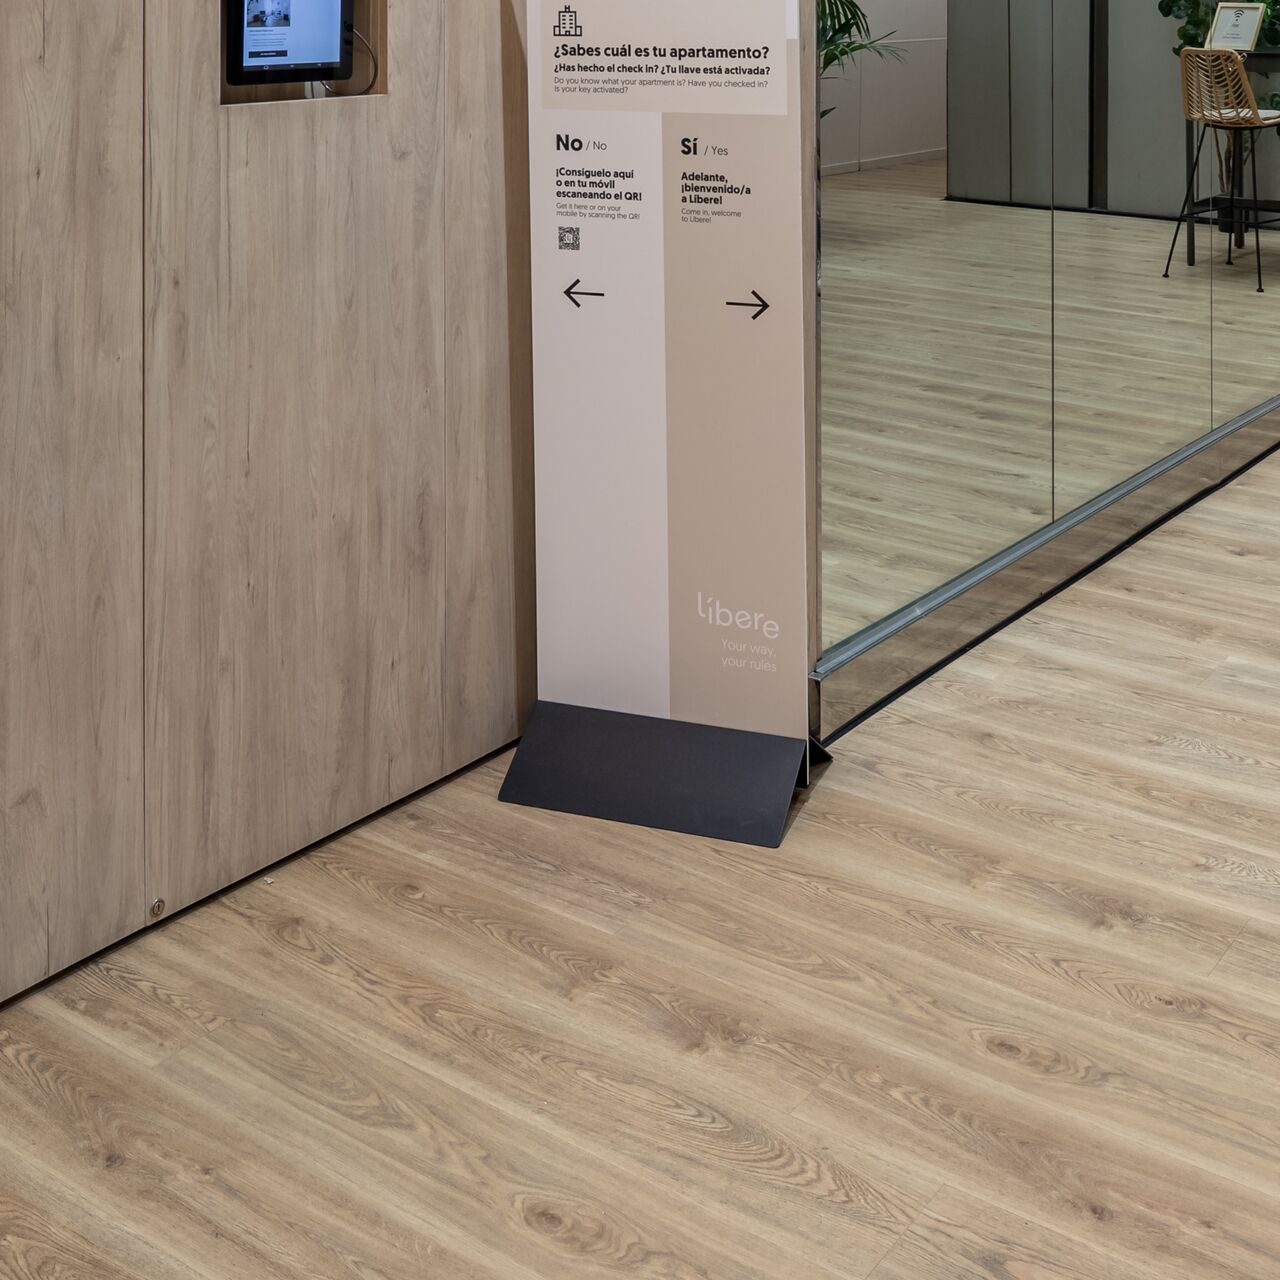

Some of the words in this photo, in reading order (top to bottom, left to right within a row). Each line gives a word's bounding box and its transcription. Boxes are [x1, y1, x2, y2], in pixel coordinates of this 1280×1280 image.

[554, 43, 601, 58] ¿Sabes
[604, 44, 631, 57] cuál
[634, 47, 650, 57] es
[652, 46, 666, 57] tu
[670, 46, 770, 60] apartamento?
[554, 63, 576, 73] ¿Has
[577, 63, 605, 72] hecho
[606, 64, 615, 73] el
[616, 64, 643, 73] check
[645, 64, 659, 73] in?
[660, 64, 677, 75] ¿Tu
[678, 65, 701, 74] llave
[703, 66, 722, 75] está
[724, 66, 771, 75] activada?
[565, 78, 579, 86] you
[580, 77, 600, 85] know
[601, 77, 619, 85] what
[638, 79, 675, 87] apartment
[688, 79, 706, 87] Have
[723, 80, 756, 88] checked
[757, 80, 769, 88] in?
[579, 86, 591, 94] key
[593, 86, 629, 94] activated?
[556, 134, 583, 151] No
[586, 140, 591, 151] /
[593, 141, 608, 151] No
[681, 137, 699, 155] Sí
[704, 145, 709, 156] /
[711, 145, 729, 156] Yes
[556, 167, 612, 179] ¡Consíguelo
[613, 169, 634, 180] aquí
[681, 171, 728, 184] Adelante,
[577, 180, 587, 188] tu
[589, 180, 615, 189] móvil
[681, 183, 751, 195] ¡bienvenido/a
[556, 190, 612, 200] escaneando
[613, 191, 623, 200] el
[624, 192, 642, 201] QR!
[588, 211, 616, 220] scanning
[702, 209, 710, 217] in,
[721, 638, 747, 652] Your
[721, 656, 747, 670] your
[750, 659, 777, 672] rules
